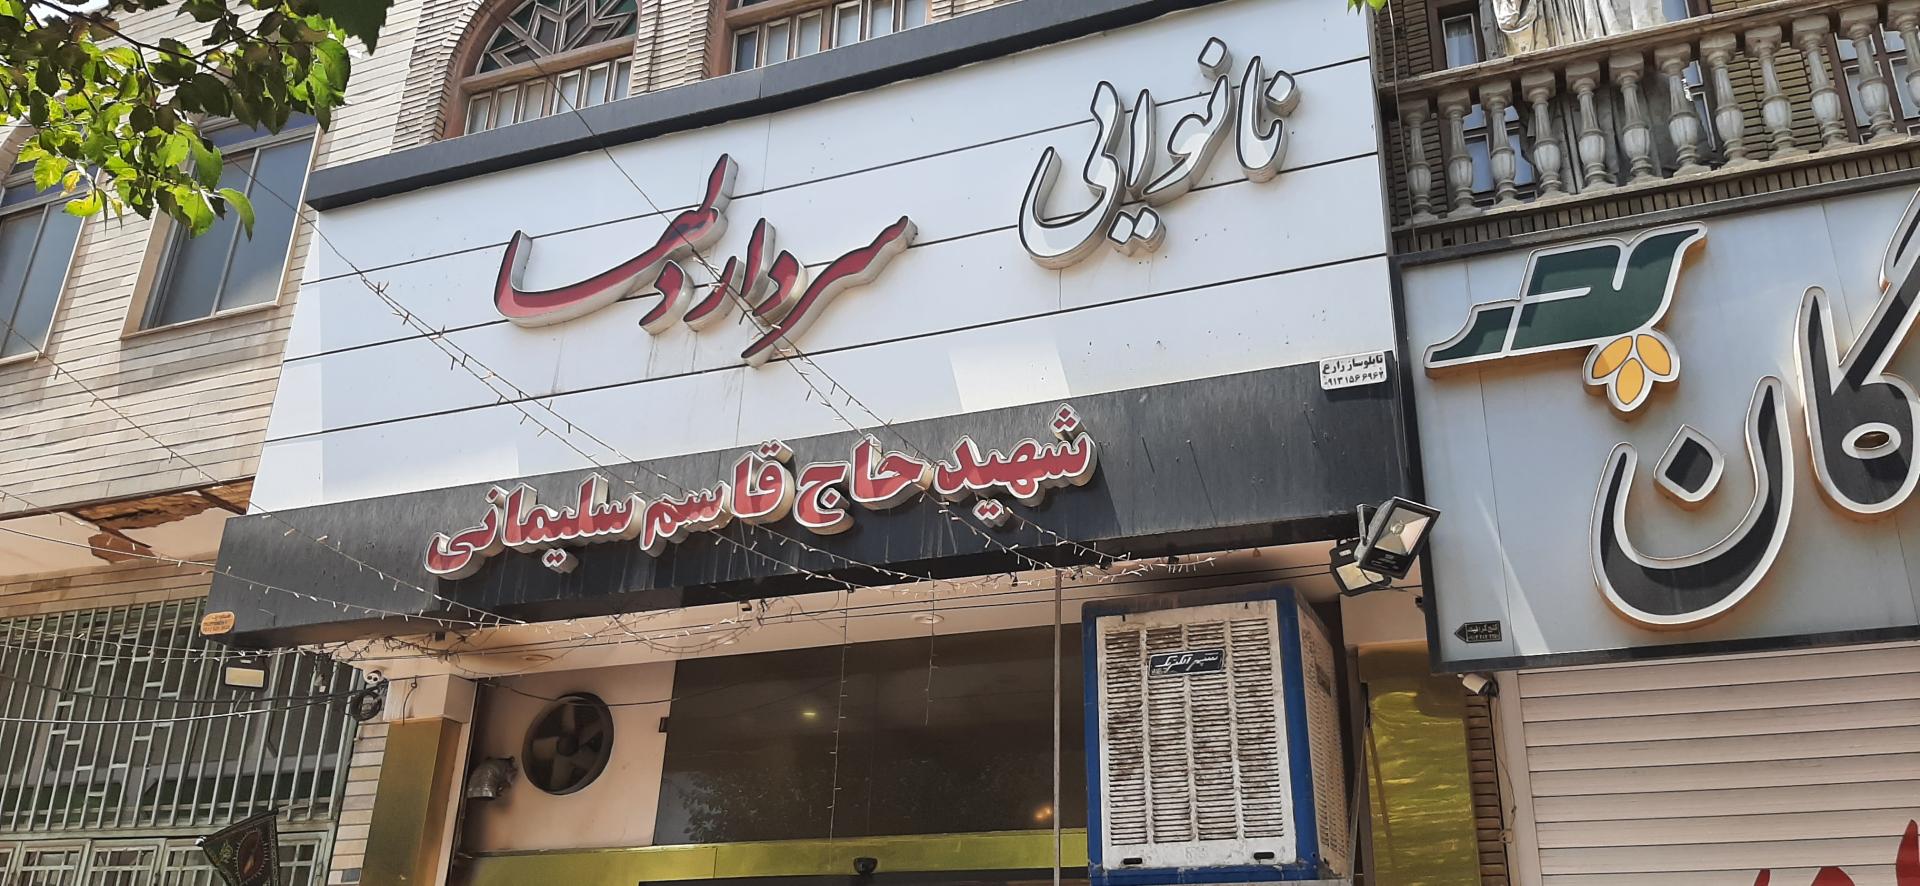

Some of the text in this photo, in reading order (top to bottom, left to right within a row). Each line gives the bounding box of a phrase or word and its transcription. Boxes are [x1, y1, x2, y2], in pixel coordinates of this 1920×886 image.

[493, 36, 1303, 368] نانوایی سردار دلها
[1322, 359, 1346, 375] زارع
[423, 401, 1097, 581] شهید حاج قاسم سلیمانی
